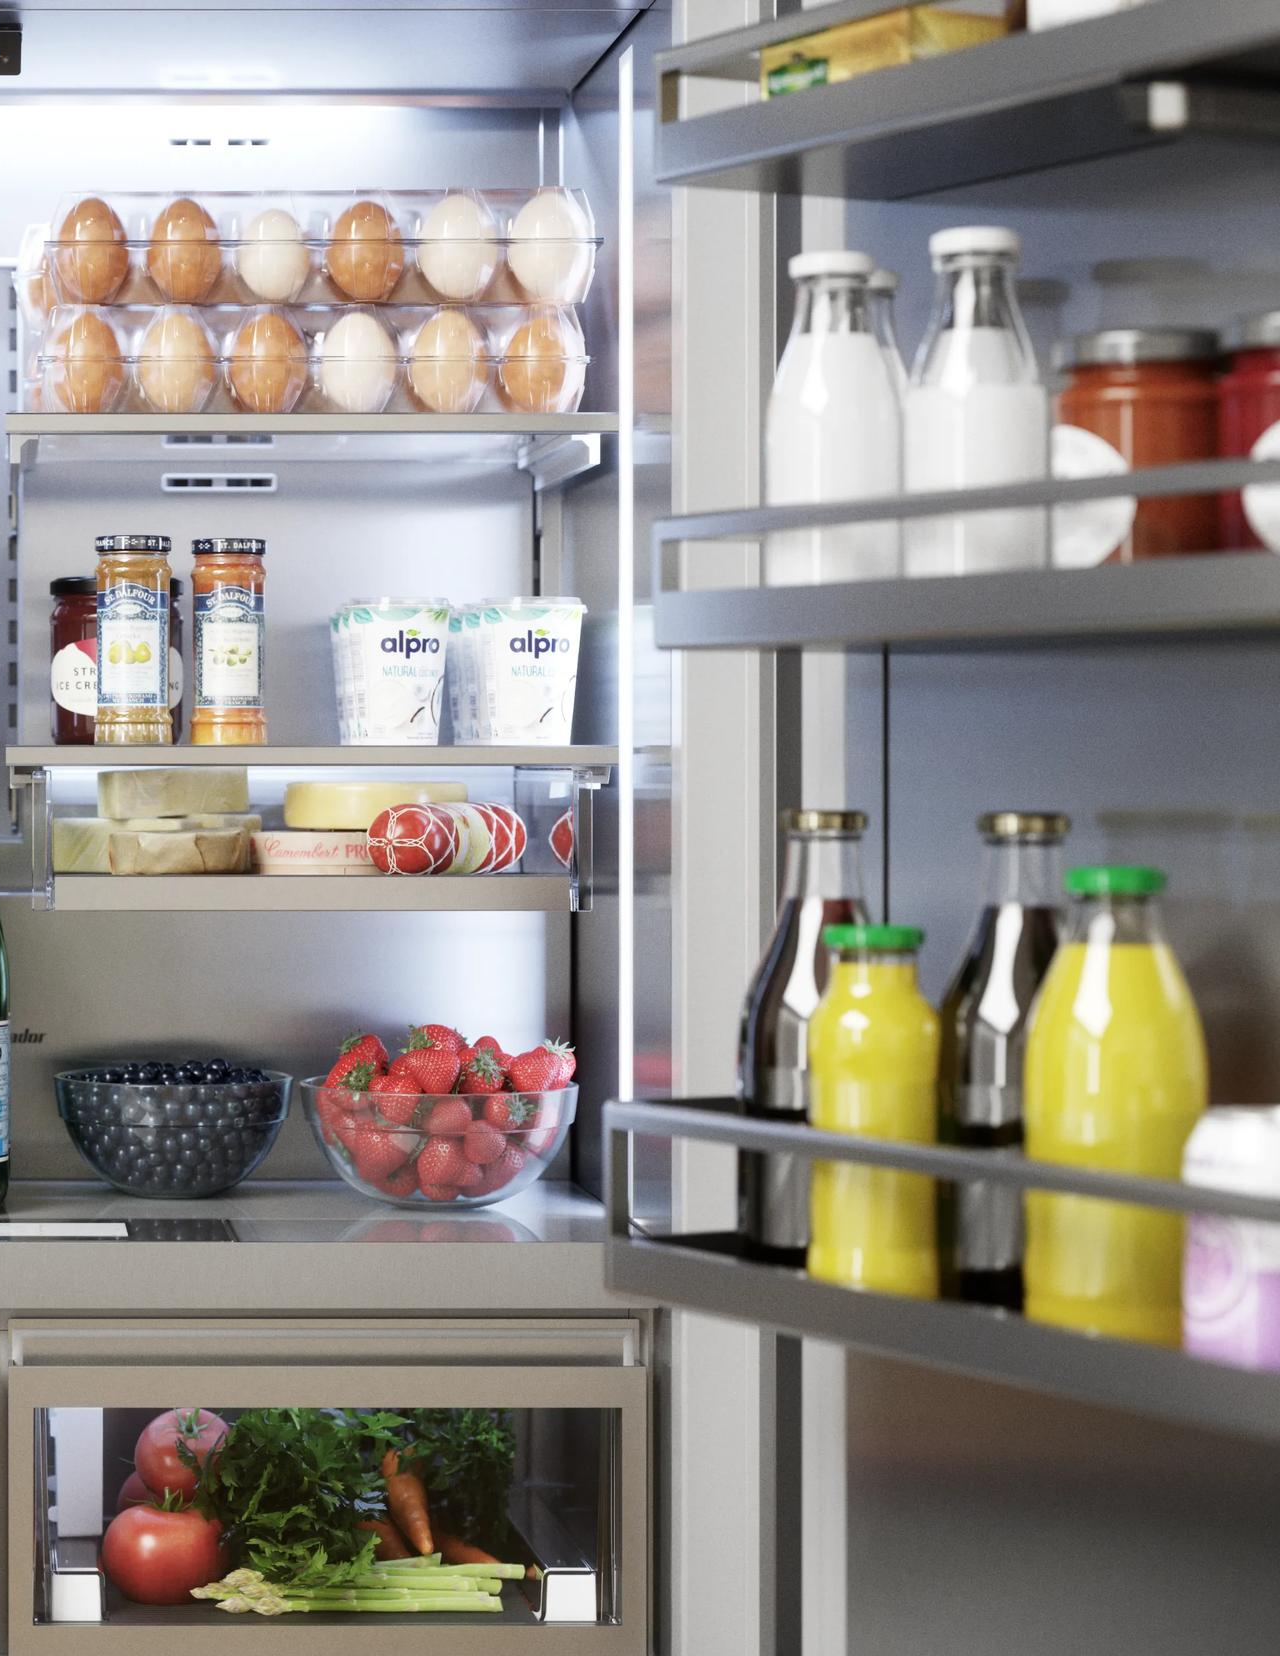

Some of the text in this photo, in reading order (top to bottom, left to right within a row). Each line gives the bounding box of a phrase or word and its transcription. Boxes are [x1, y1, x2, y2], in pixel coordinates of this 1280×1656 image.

[116, 589, 156, 605] DALFOUR
[381, 629, 440, 659] alpro
[509, 629, 570, 659] alpro
[382, 665, 417, 678] NATURAL
[75, 681, 97, 690] CRE
